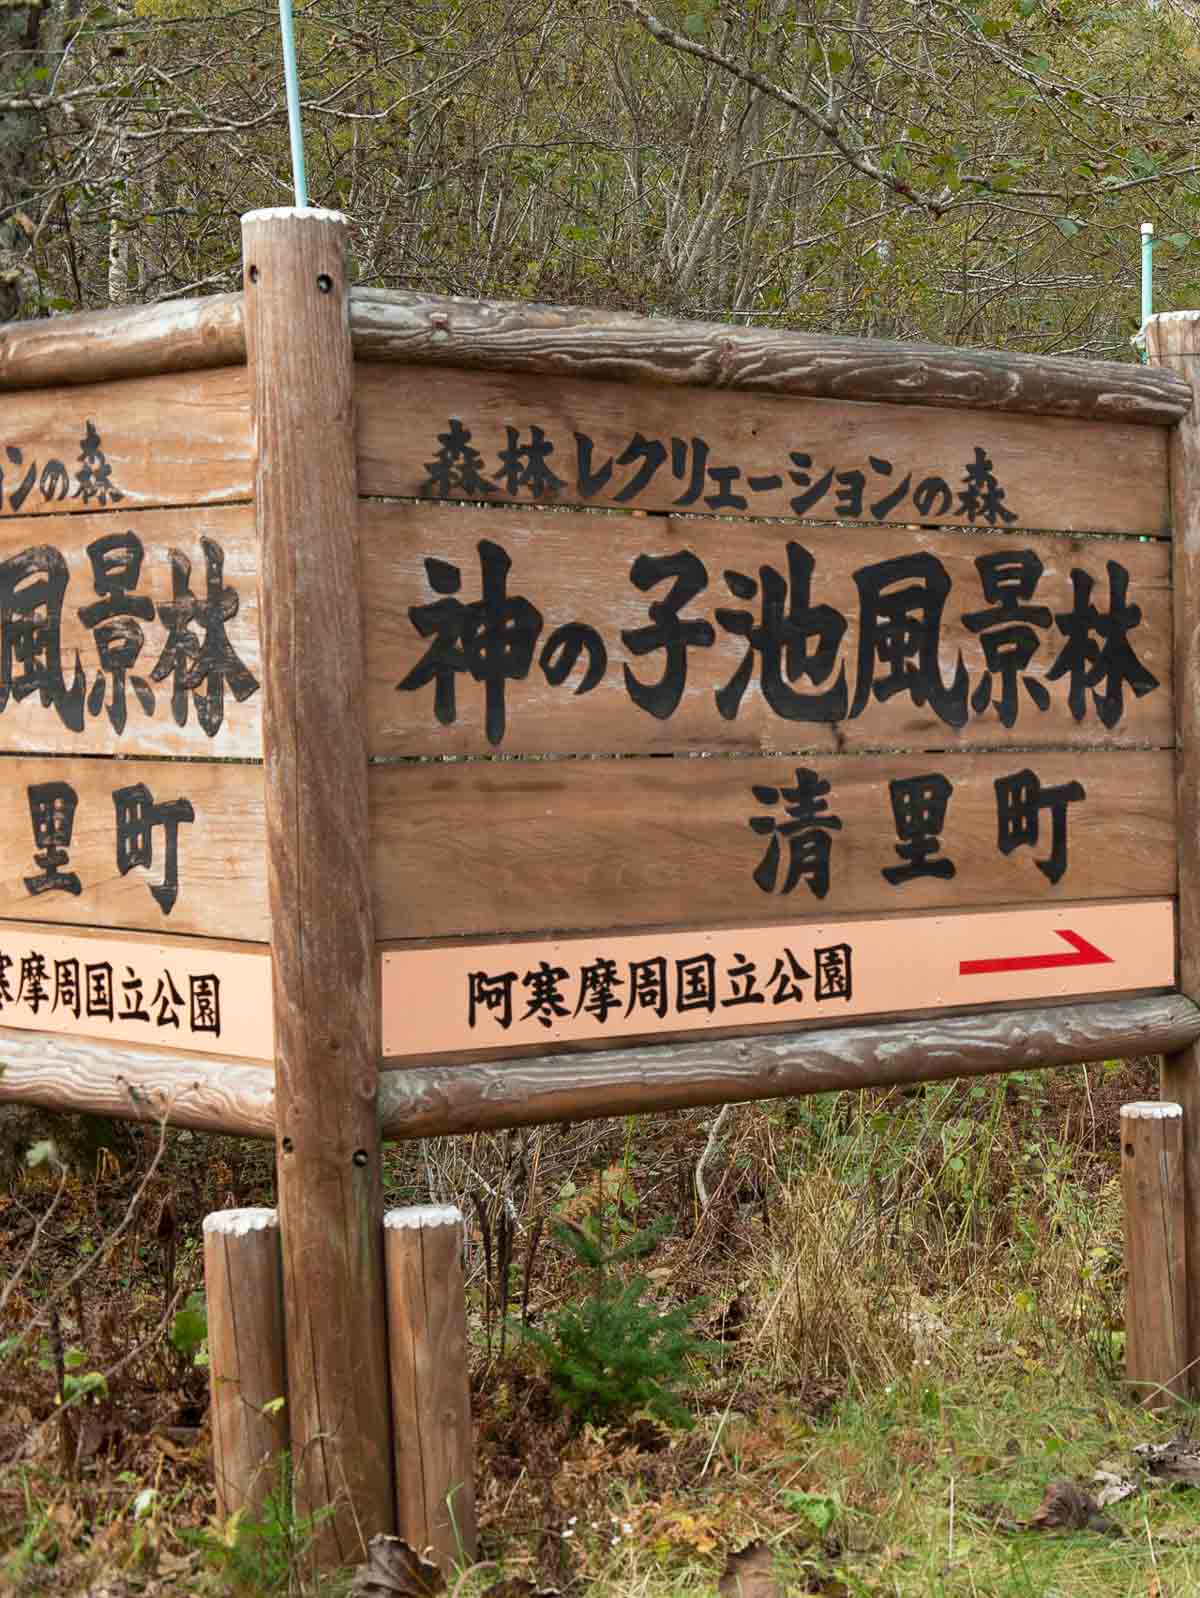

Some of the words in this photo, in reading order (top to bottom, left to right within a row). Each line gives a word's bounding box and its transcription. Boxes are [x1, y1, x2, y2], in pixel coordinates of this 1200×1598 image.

[0, 418, 125, 512] ンの森
[422, 418, 1018, 525] 森林レクリエーションの森
[395, 538, 1161, 746] 神の子池風景林
[24, 781, 195, 915] 里町
[748, 767, 1087, 900] 清里町
[467, 942, 854, 1029] 阿寒摩周国立公園
